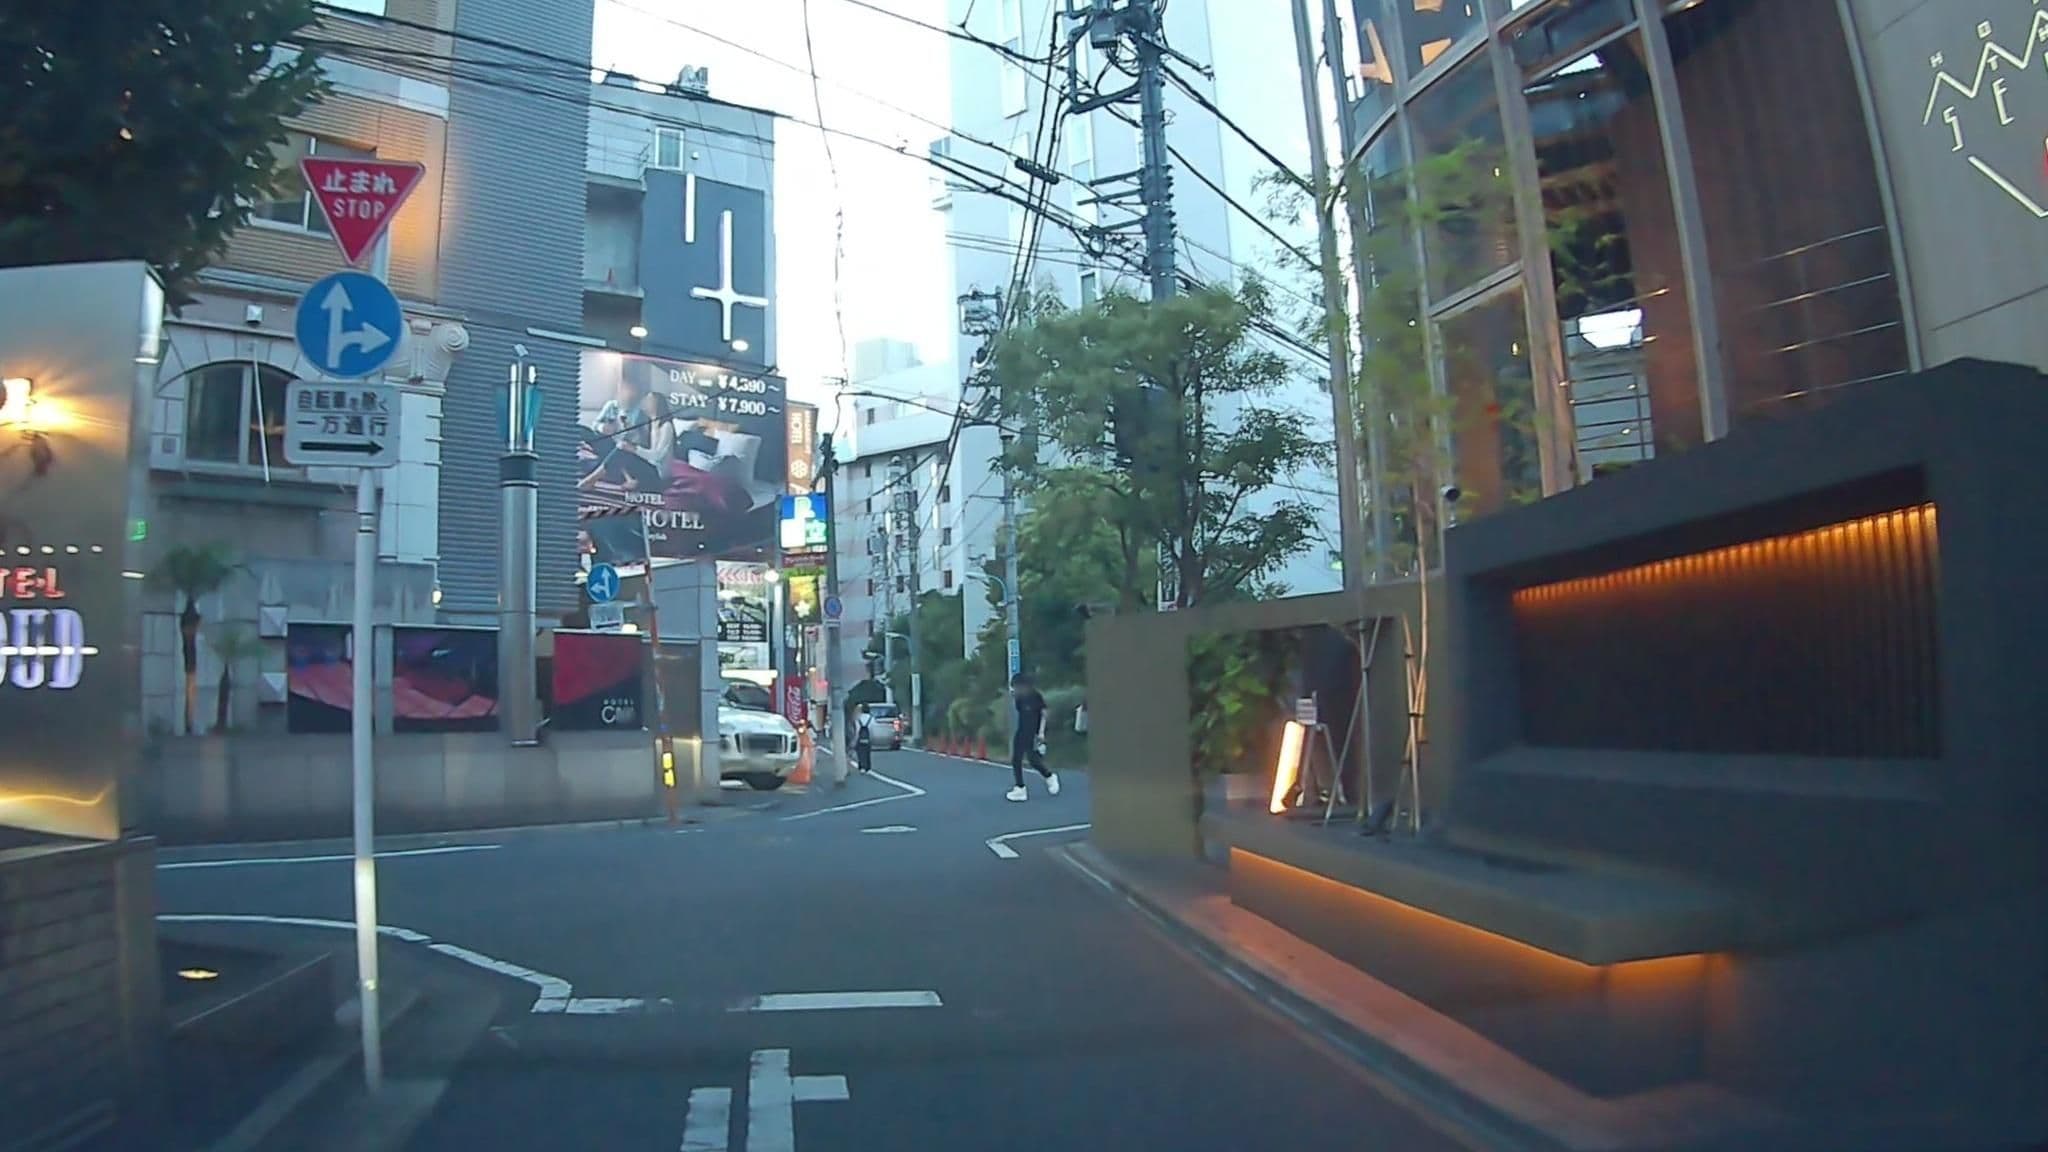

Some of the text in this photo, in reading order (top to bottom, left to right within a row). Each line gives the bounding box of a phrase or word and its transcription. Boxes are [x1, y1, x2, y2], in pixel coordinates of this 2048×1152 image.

[321, 168, 399, 195] 止まれ
[333, 198, 385, 219] STOP
[670, 369, 697, 385] DAY
[670, 393, 708, 408] STAY
[296, 415, 388, 436] 一方通行
